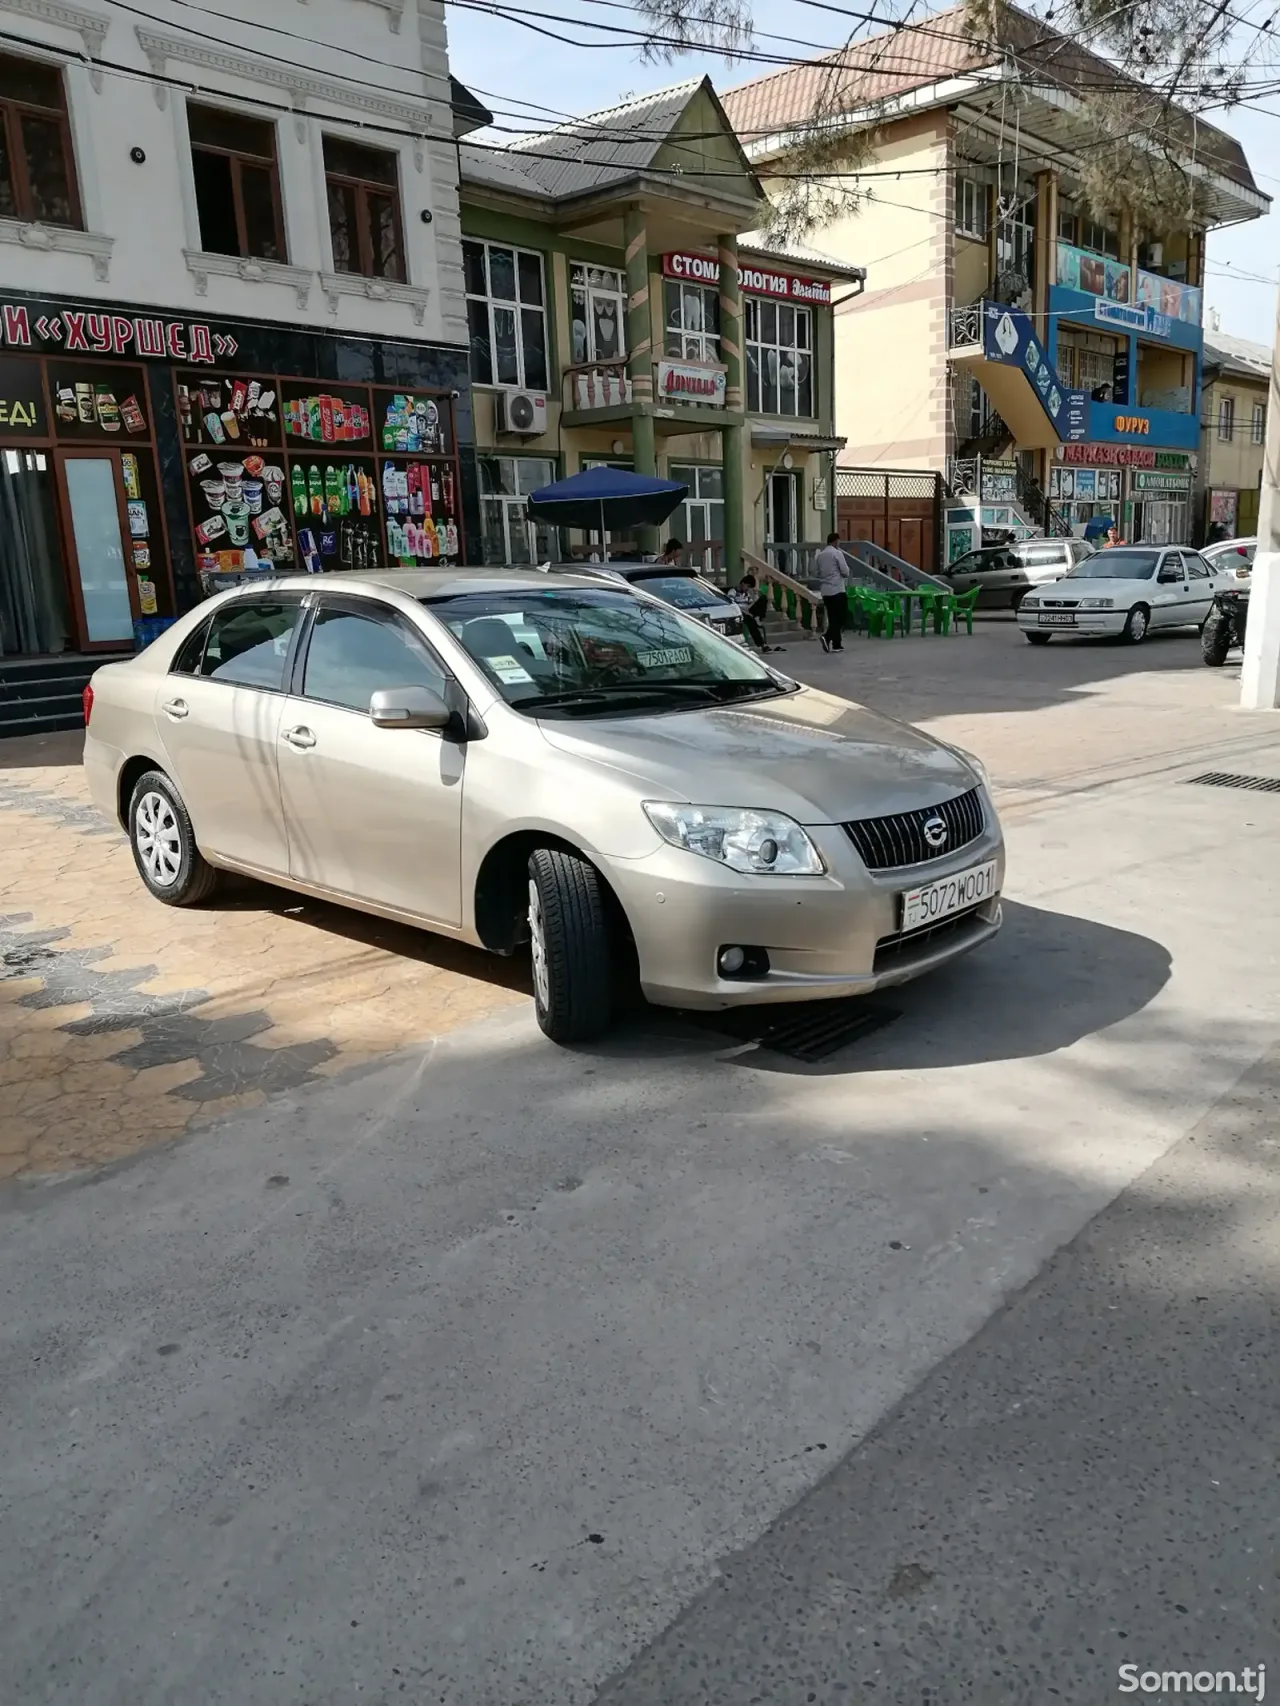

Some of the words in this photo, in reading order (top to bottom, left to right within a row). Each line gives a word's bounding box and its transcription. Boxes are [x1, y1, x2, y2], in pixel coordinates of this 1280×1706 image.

[672, 254, 788, 294] СТОМОЛОГИЯ
[0, 304, 32, 346] И
[34, 310, 239, 364] «ХУРШЕД»
[1115, 415, 1150, 435] ФУРУЗ
